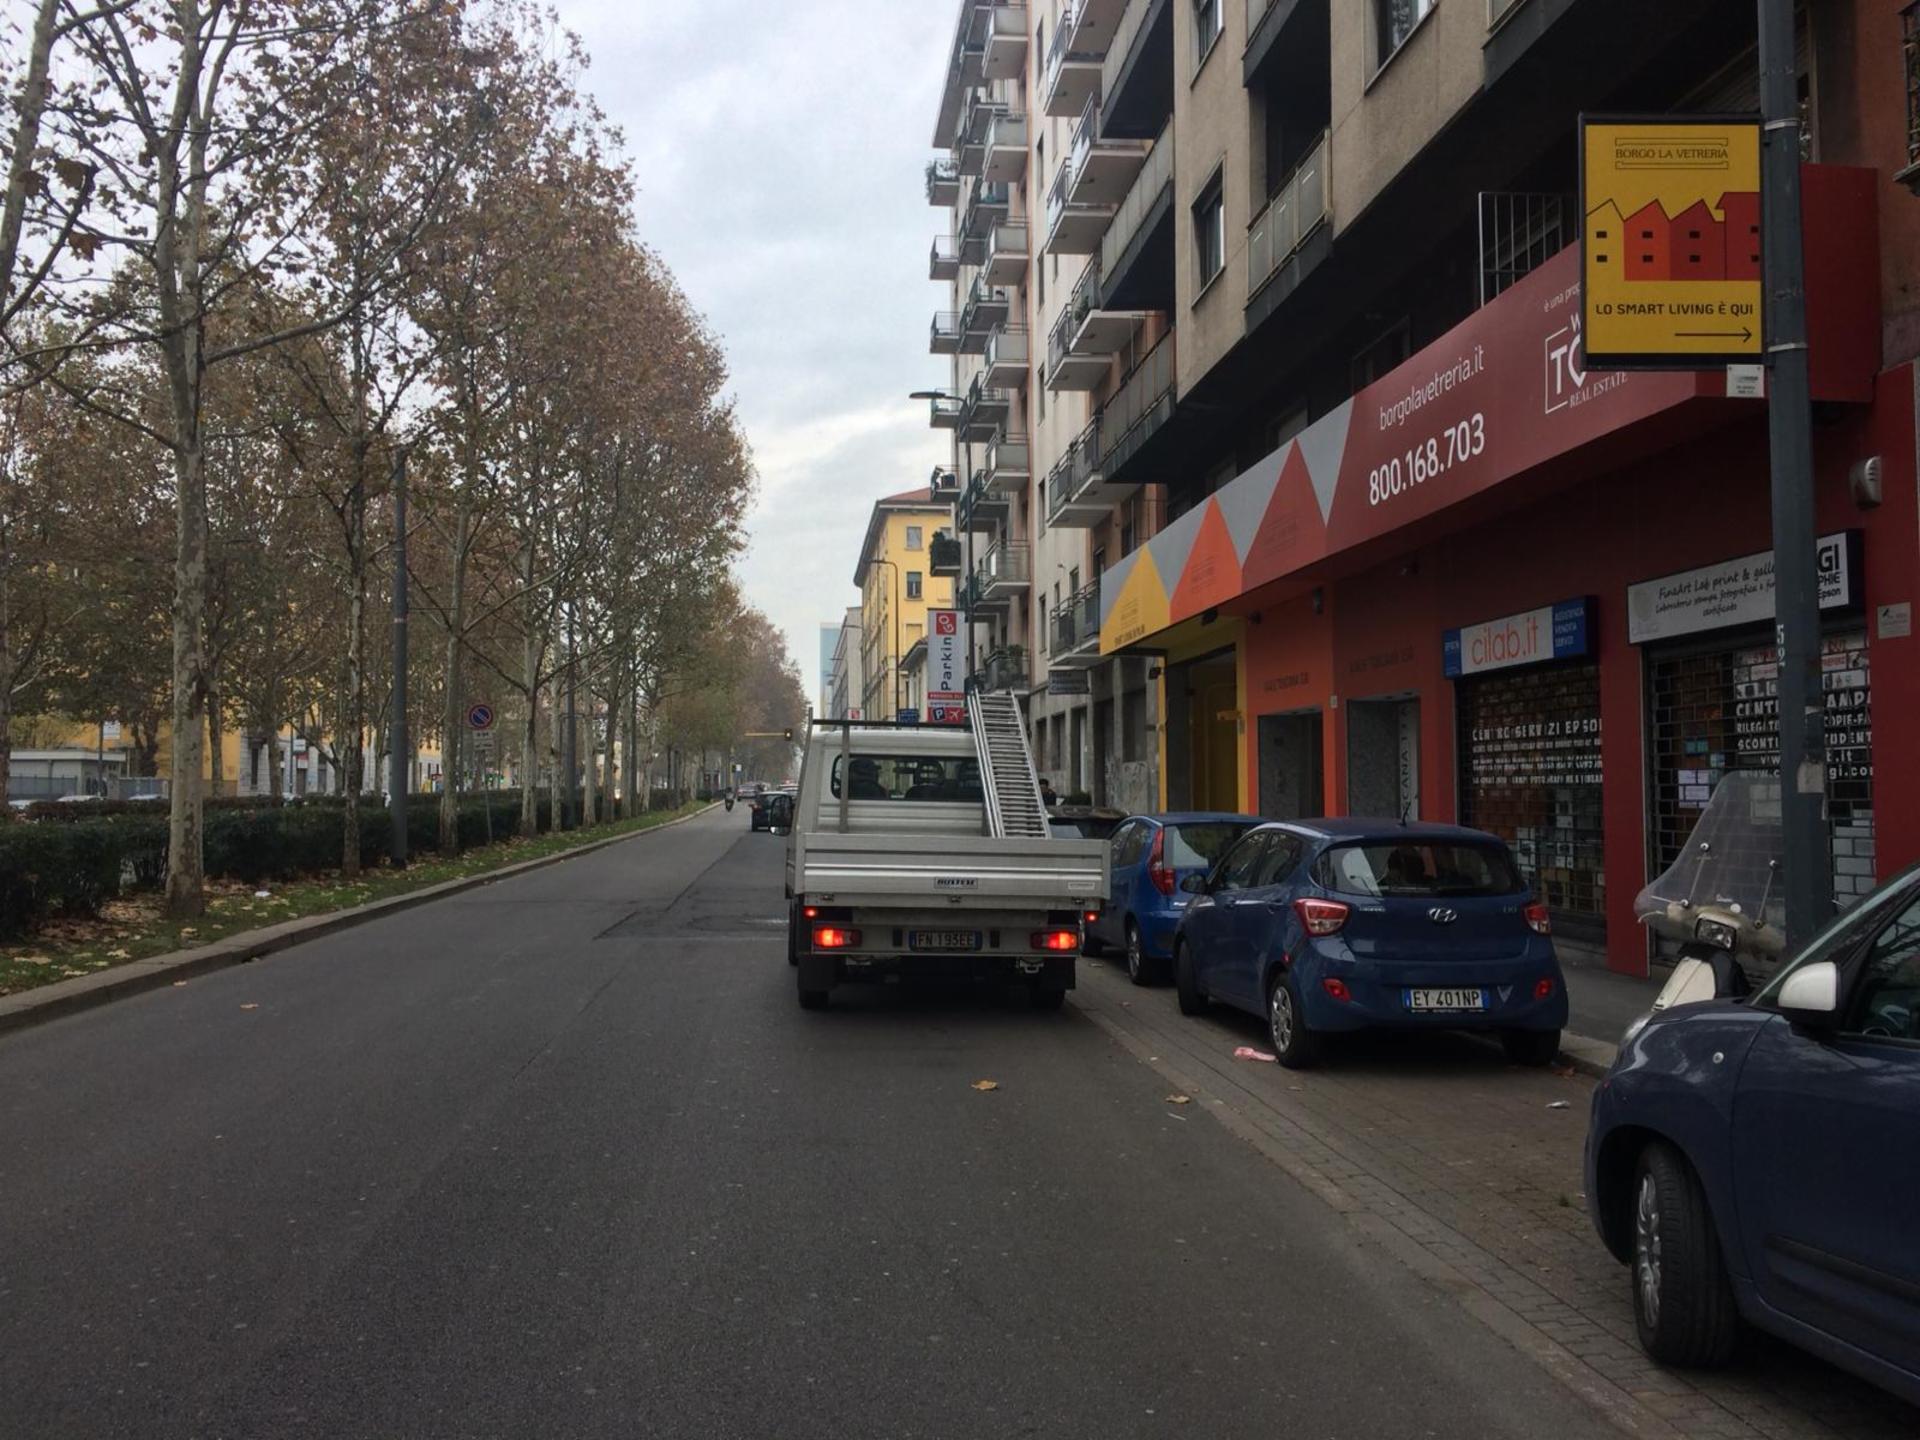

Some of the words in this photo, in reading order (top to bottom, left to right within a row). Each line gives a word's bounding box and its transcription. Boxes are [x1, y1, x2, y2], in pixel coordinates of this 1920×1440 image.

[1615, 148, 1655, 159] BORGO
[1658, 149, 1673, 159] LA
[1676, 148, 1729, 159] VETRERIA
[1595, 303, 1612, 315] LO
[1617, 303, 1664, 315] SMART
[1669, 303, 1714, 315] LIVING
[1719, 300, 1726, 315] È
[1730, 303, 1753, 316] QUI
[1380, 344, 1485, 430] borgolavetreria.it
[1569, 385, 1592, 408] REAL
[1593, 371, 1629, 398] ESTATE
[1369, 412, 1486, 506] 800.168.703
[1694, 577, 1709, 593] Lab
[1712, 570, 1741, 592] print
[1471, 615, 1540, 666] cilab.it
[1413, 991, 1430, 1006] EY
[1437, 991, 1479, 1006] 401NP
